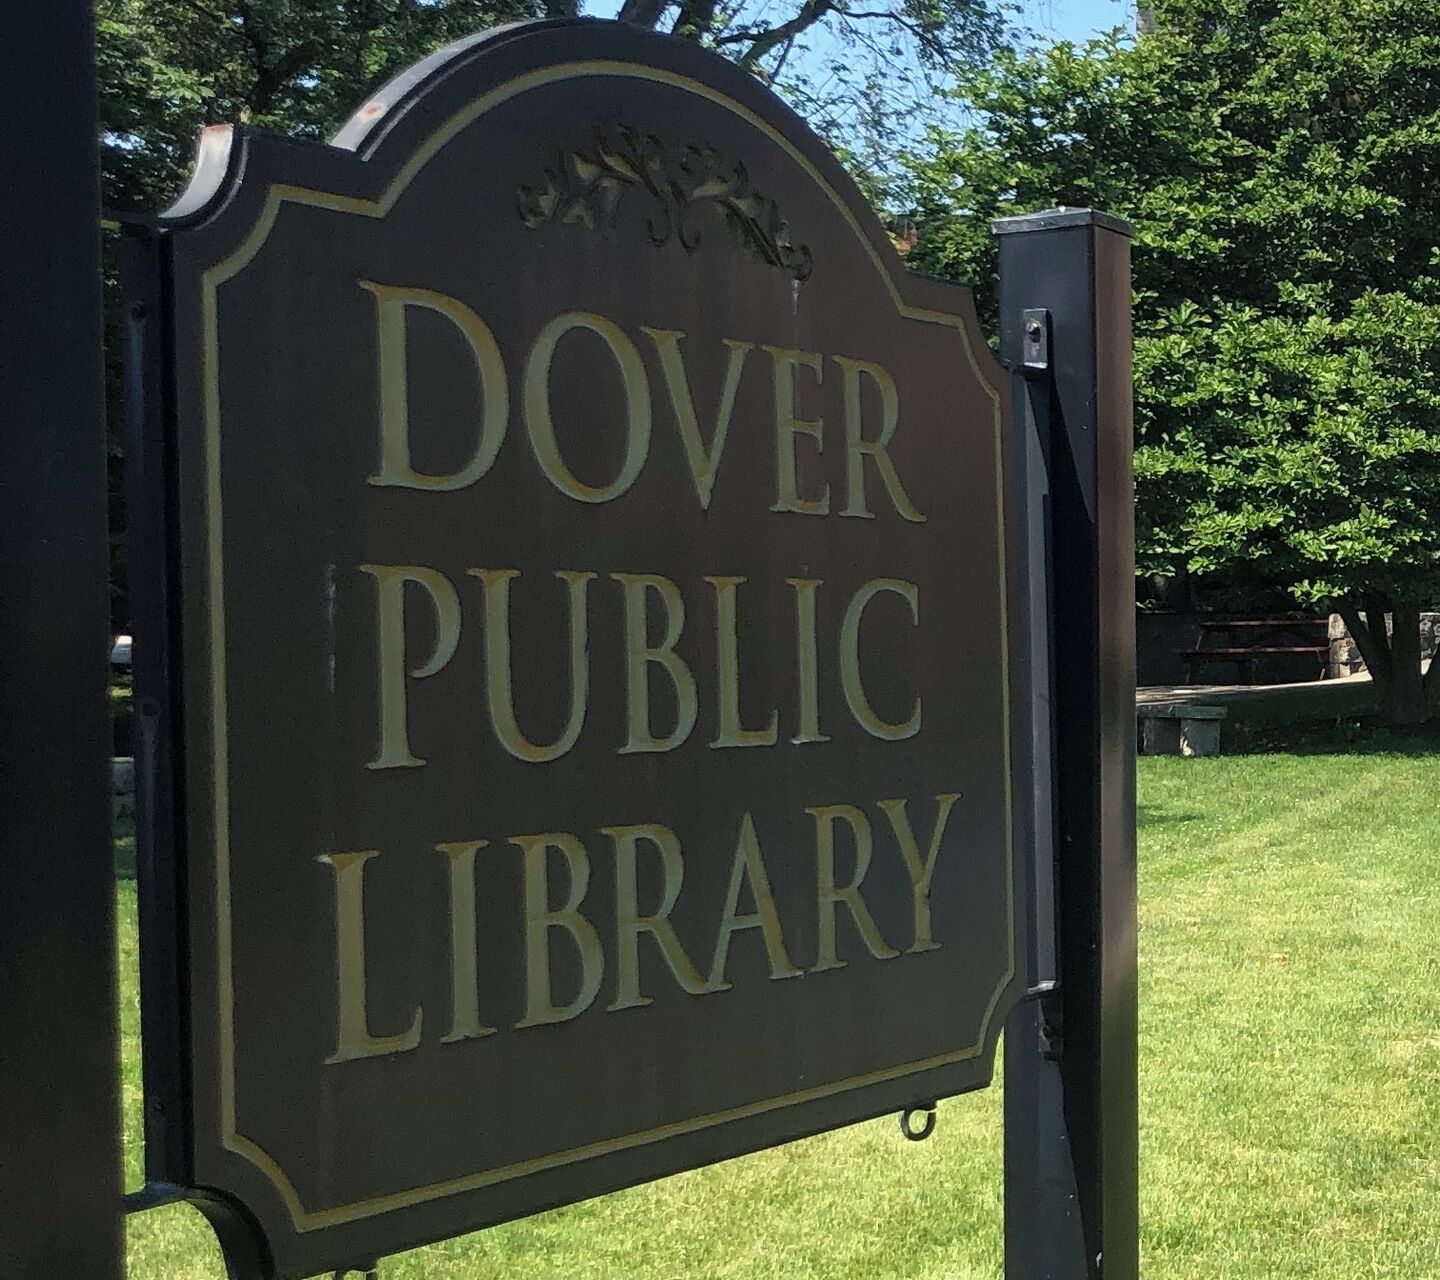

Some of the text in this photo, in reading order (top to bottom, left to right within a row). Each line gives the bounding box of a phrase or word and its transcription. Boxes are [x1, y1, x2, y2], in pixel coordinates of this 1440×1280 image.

[359, 280, 928, 523] DOVER
[358, 563, 924, 772] PUBLIC
[322, 793, 963, 1064] LIBRARY
